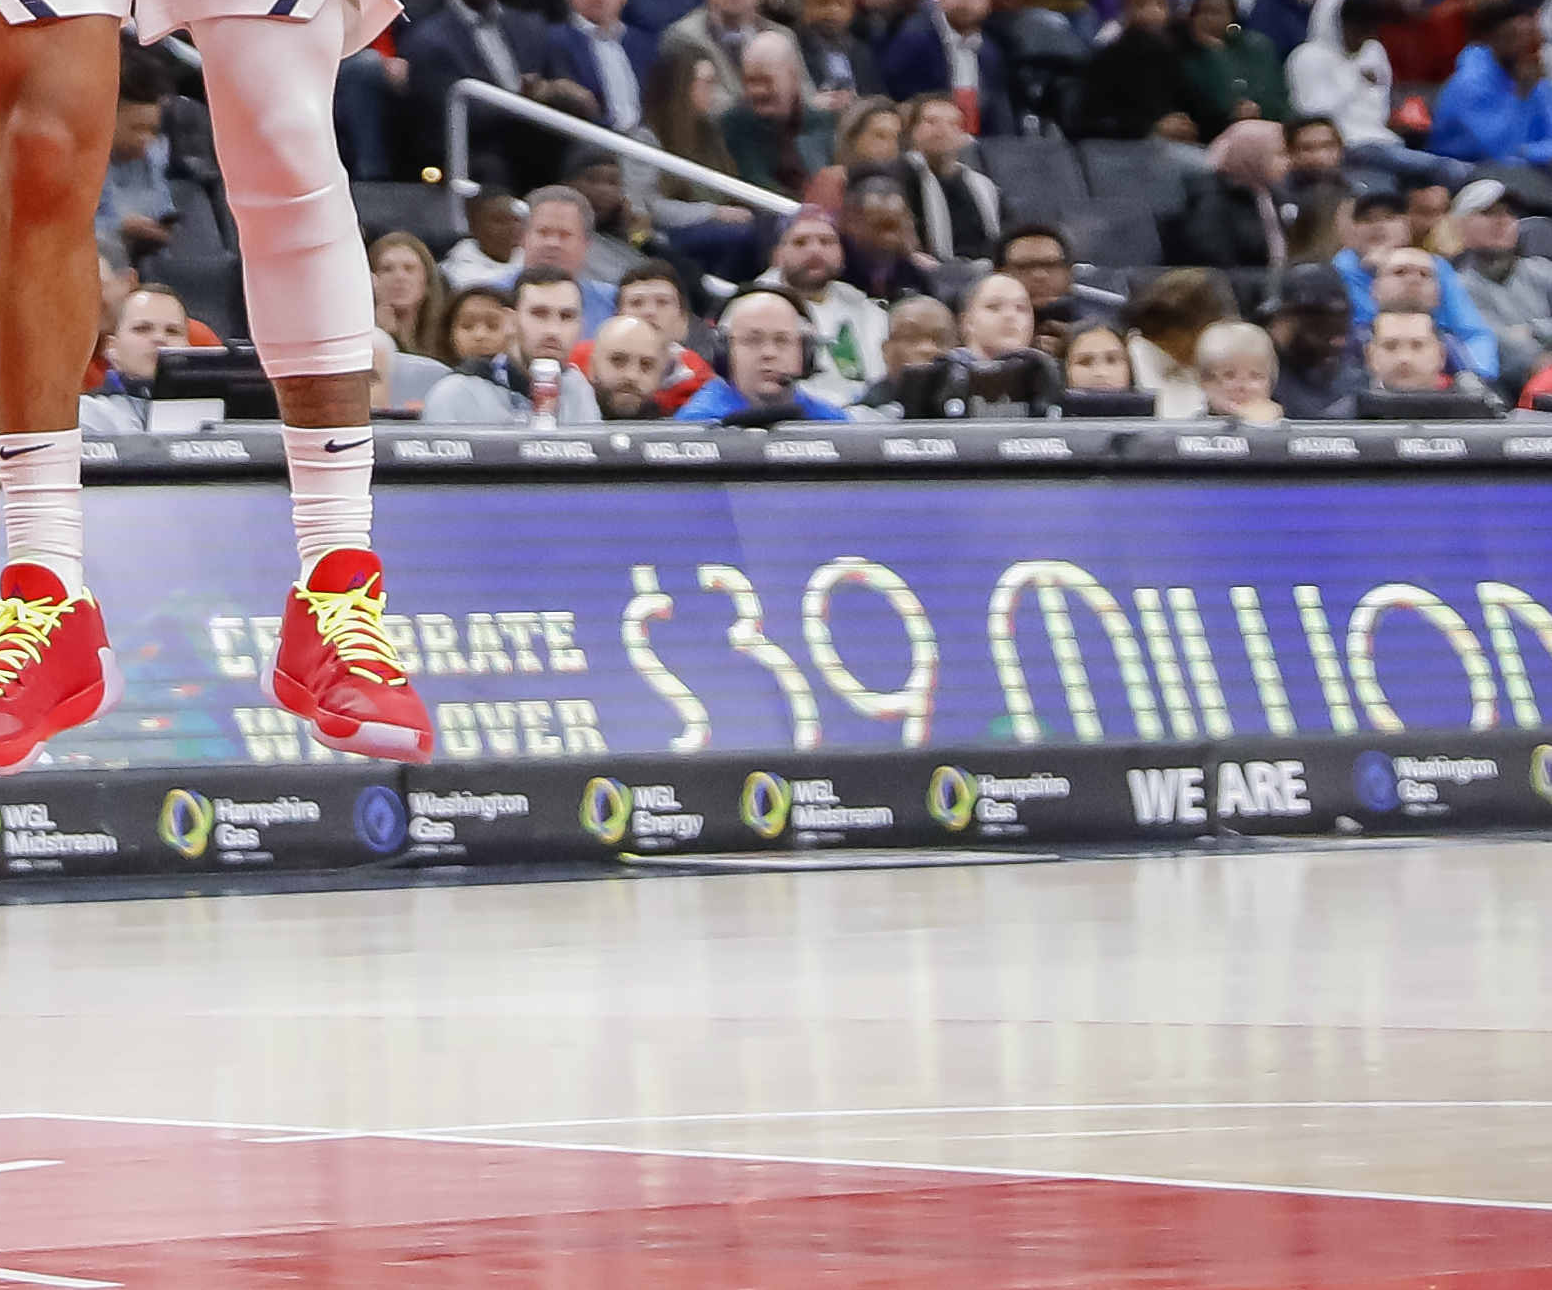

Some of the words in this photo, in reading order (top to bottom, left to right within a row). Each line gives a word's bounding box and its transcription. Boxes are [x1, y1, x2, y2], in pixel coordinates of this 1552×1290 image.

[437, 699, 610, 761] OVER
[407, 790, 531, 821] Washington
[631, 784, 684, 811] WGL
[792, 778, 842, 805] WGL
[1126, 767, 1208, 824] WE
[1216, 759, 1312, 818] ARE
[0, 803, 59, 830] WGL
[2, 829, 119, 857] Midstream
